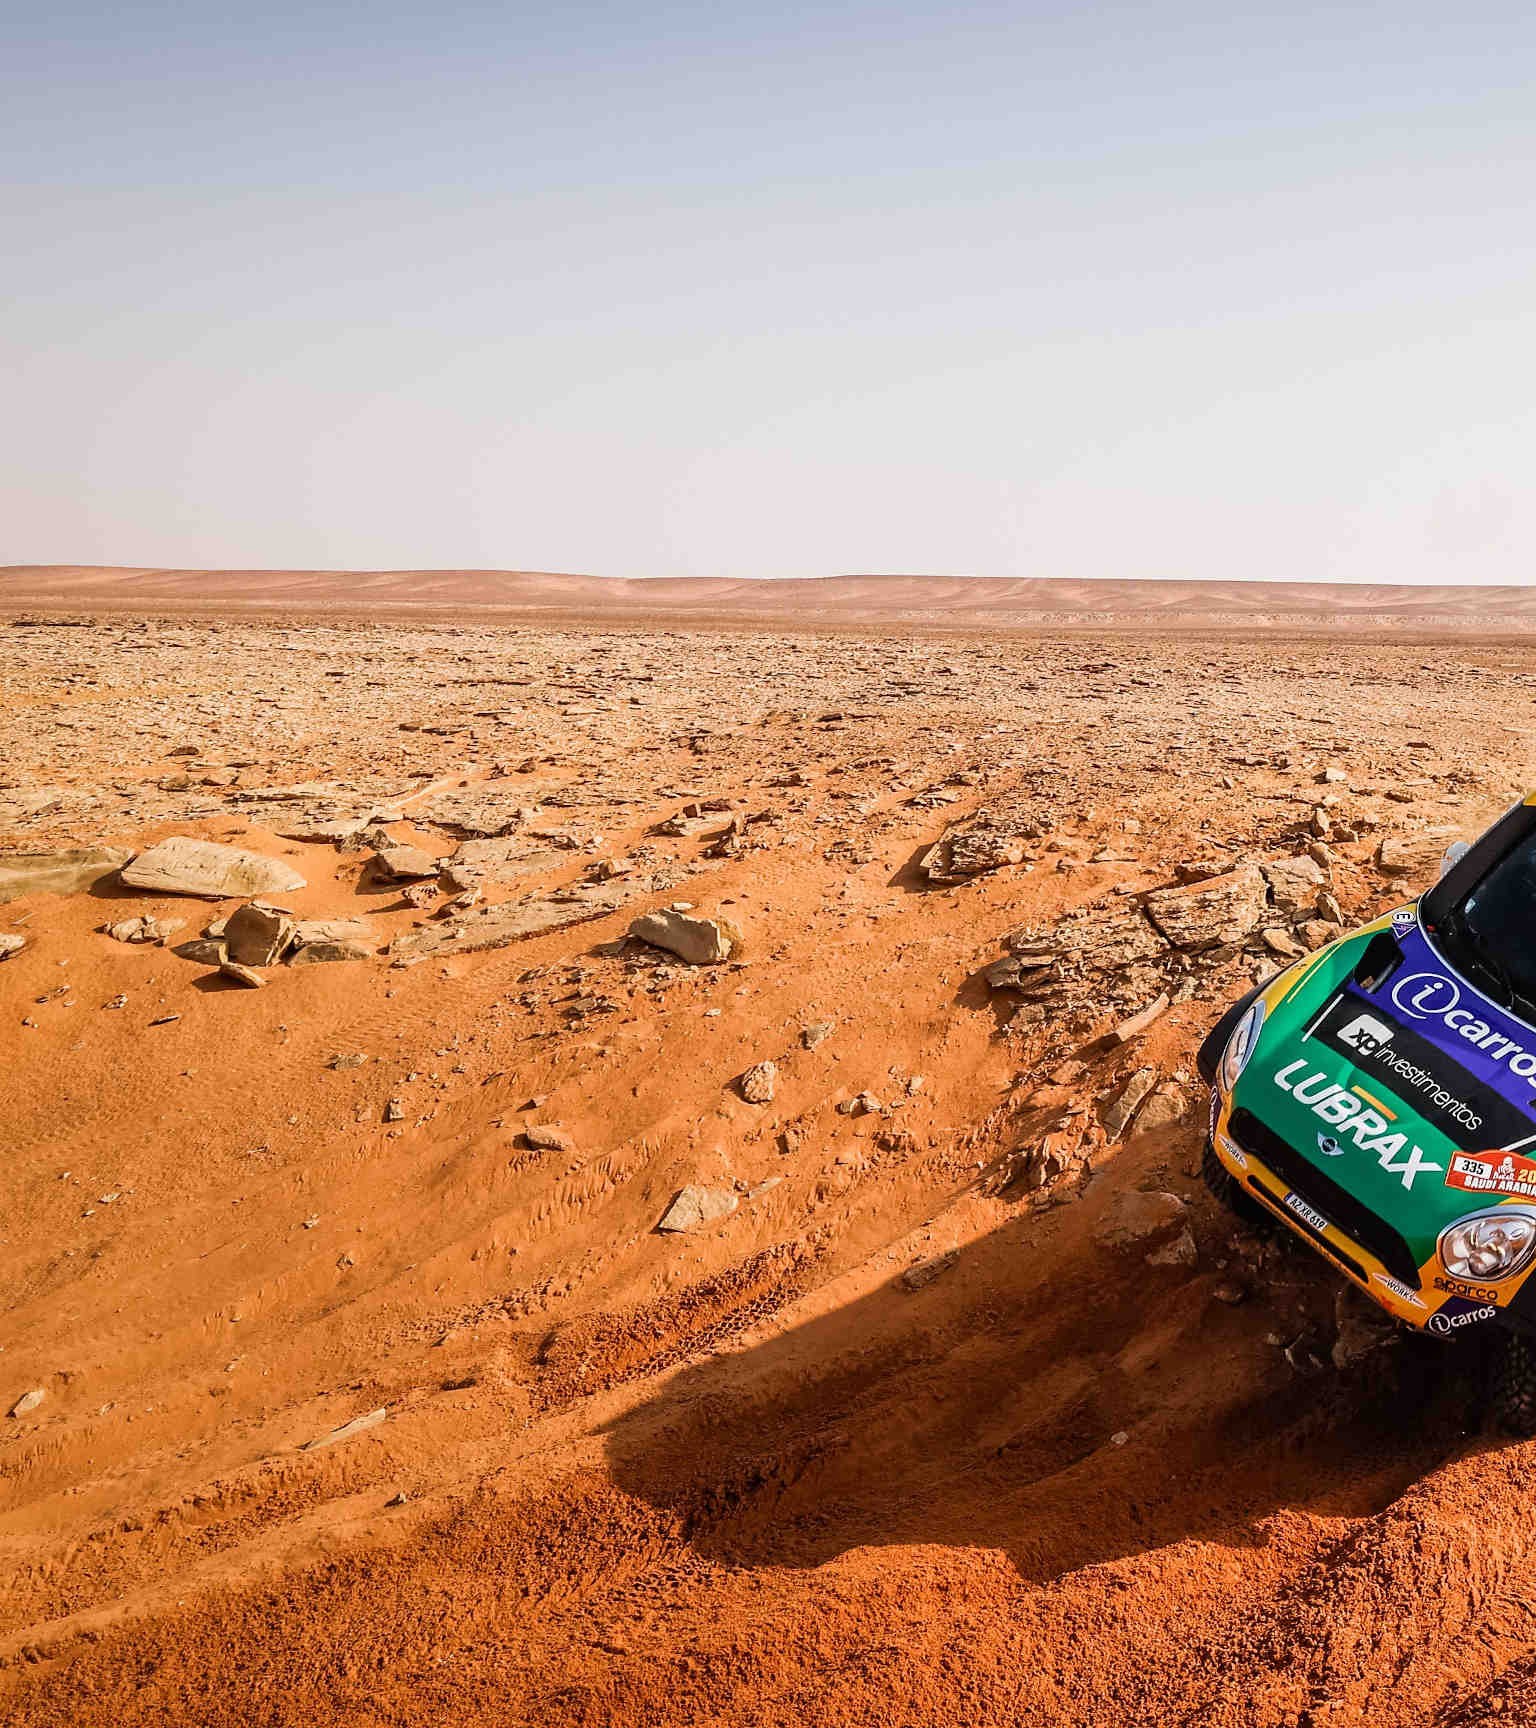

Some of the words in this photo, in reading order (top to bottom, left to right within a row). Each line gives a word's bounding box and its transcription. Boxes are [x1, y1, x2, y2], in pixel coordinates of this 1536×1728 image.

[1375, 1044, 1483, 1131] investimentos
[1274, 1058, 1444, 1191] LUBRAX
[1462, 1159, 1484, 1175] 335
[1464, 1175, 1495, 1190] SAUDI
[1386, 1279, 1414, 1303] WORKS
[1433, 1277, 1499, 1301] sparco
